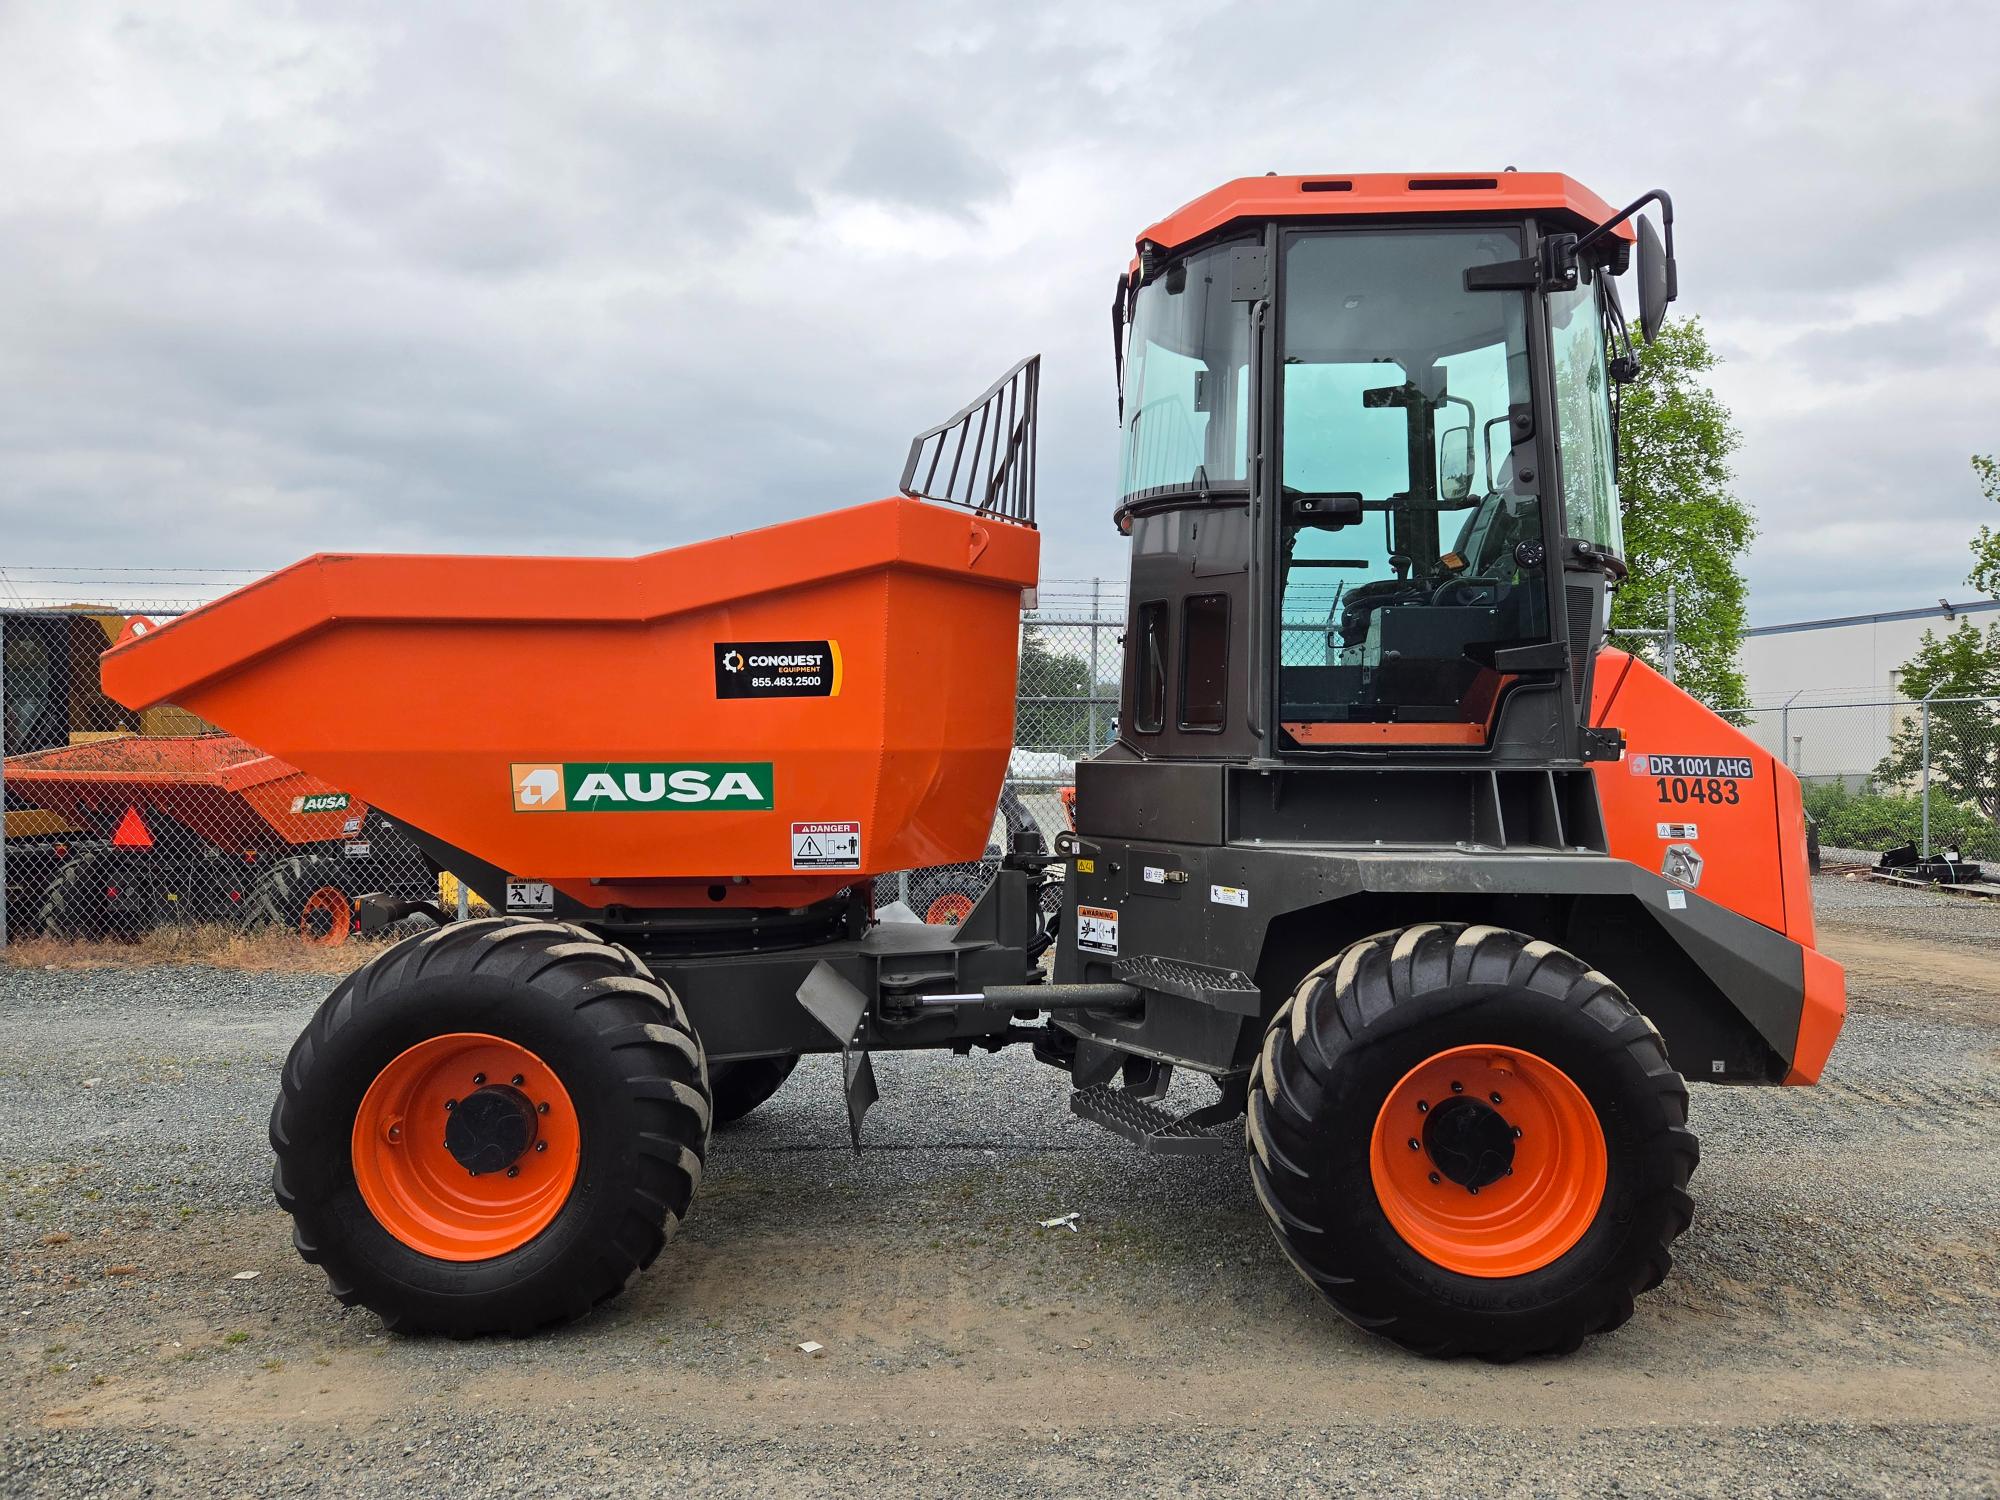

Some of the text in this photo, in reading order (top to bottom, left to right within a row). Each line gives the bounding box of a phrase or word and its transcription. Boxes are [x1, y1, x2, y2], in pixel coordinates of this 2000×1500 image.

[748, 655, 823, 667] CONQUEST
[752, 676, 821, 687] 855.483.2500
[1649, 757, 1751, 777] DR 1001 AHG
[572, 770, 765, 803] AUSA
[1656, 777, 1740, 804] 10483
[304, 796, 347, 810] AUSA
[810, 825, 850, 833] DANGER
[1086, 909, 1114, 919] WARNING
